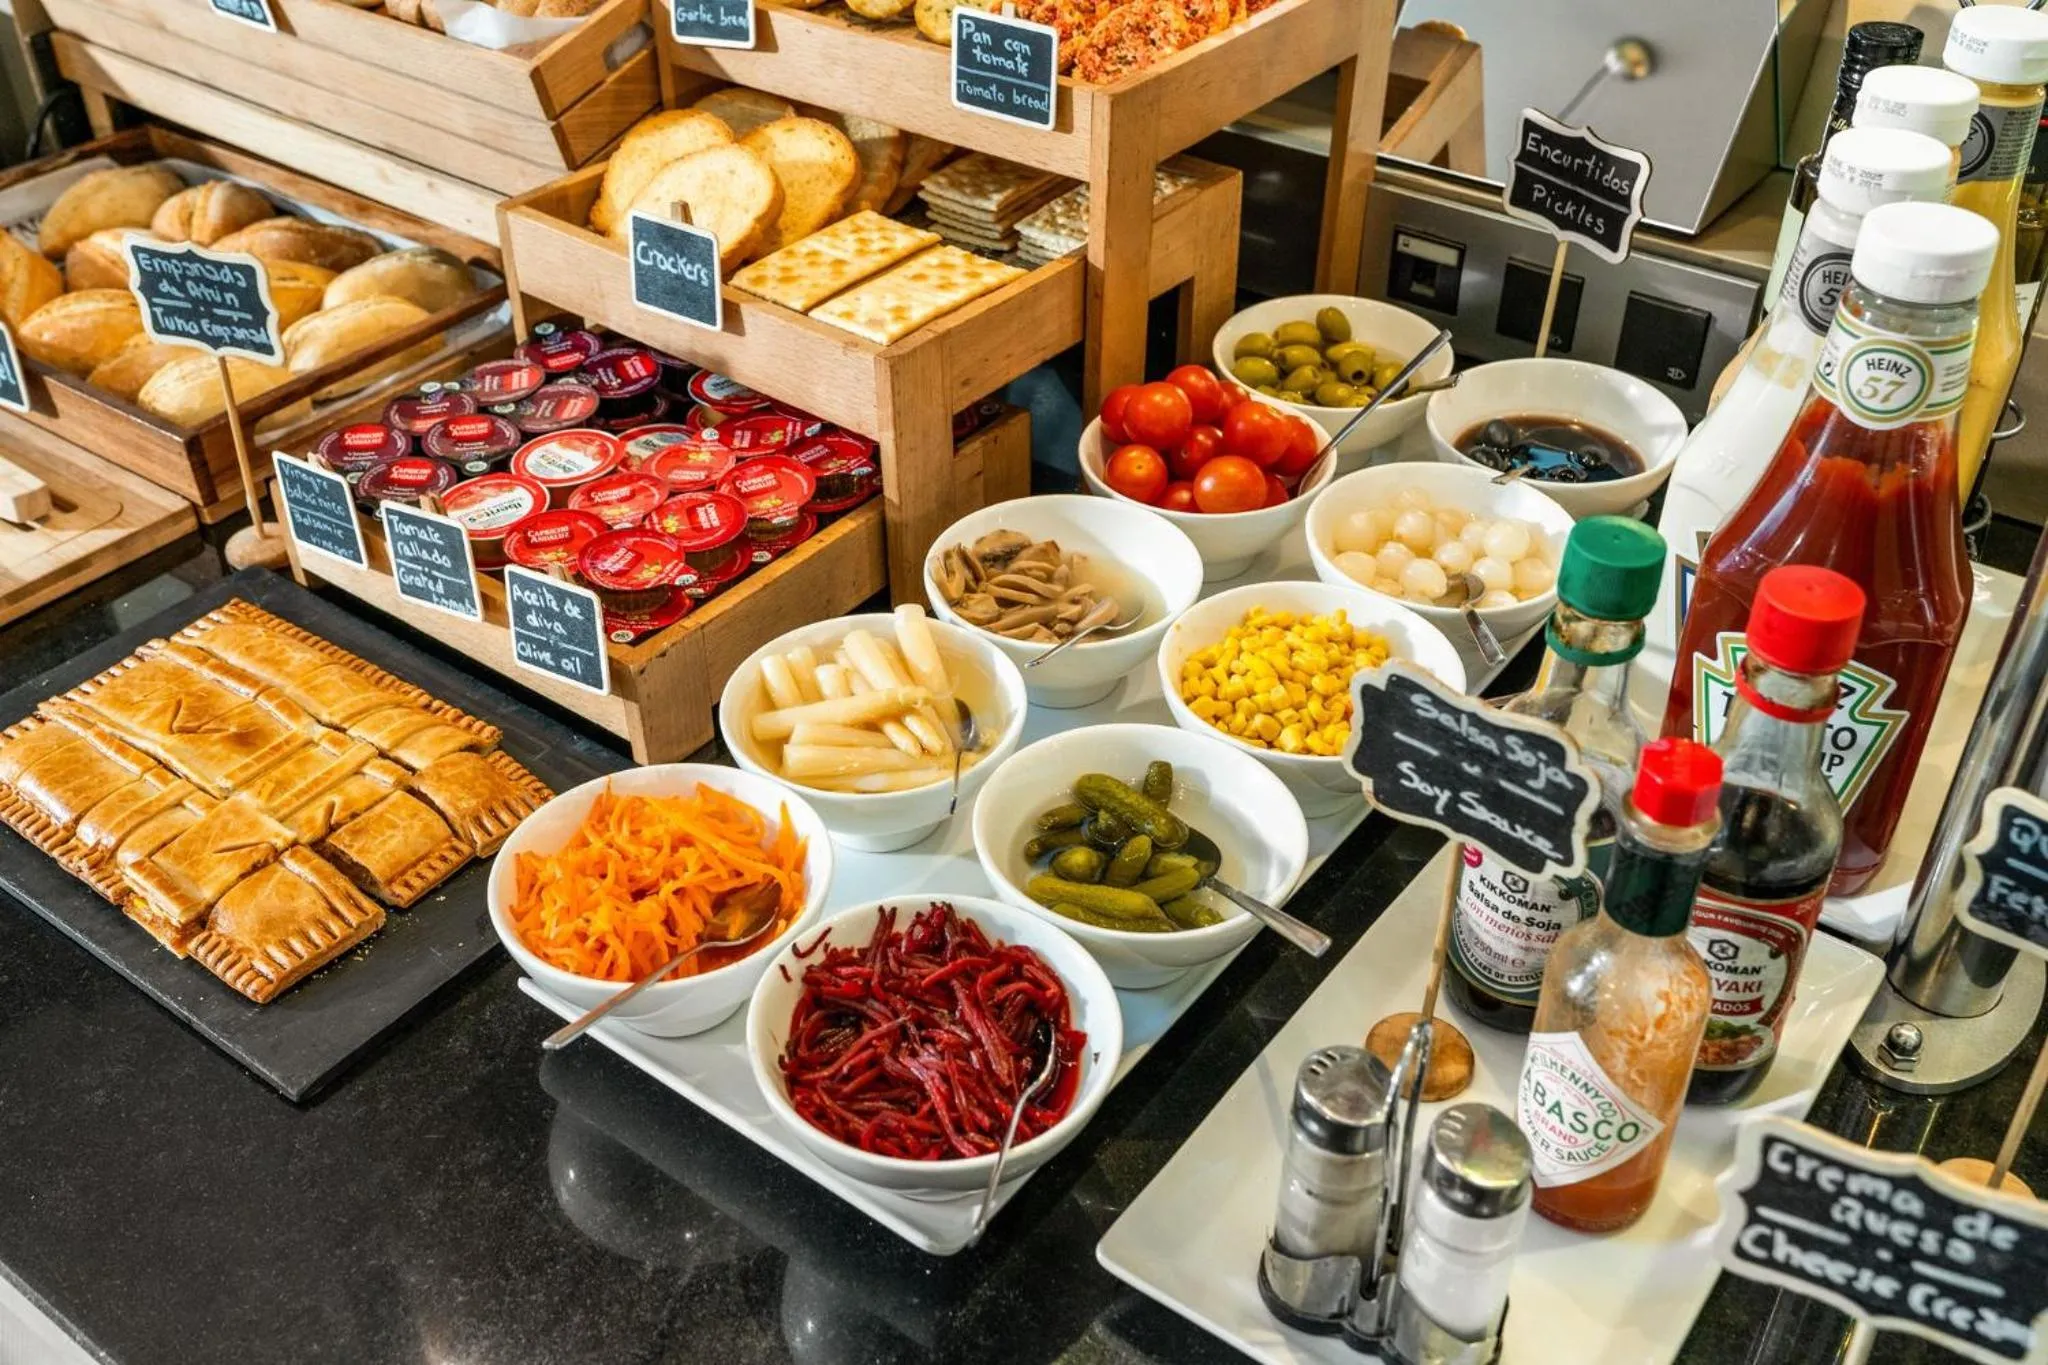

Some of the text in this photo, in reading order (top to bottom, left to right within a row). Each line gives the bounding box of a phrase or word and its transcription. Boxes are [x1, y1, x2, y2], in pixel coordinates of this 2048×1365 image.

[961, 19, 1031, 56] Pan con
[972, 46, 1029, 77] tomate
[958, 80, 1050, 112] Tomato bread
[1526, 132, 1630, 195] Encurtidos
[1532, 184, 1605, 234] Pickles
[137, 252, 247, 288] Empanada
[636, 241, 709, 287] Crackers
[1818, 288, 1842, 306] 5
[1866, 358, 1912, 379] HEINZ
[1856, 376, 1907, 404] 57
[388, 514, 445, 545] Tomate
[397, 541, 452, 568] rallado
[512, 583, 560, 612] Aceite
[517, 641, 581, 675] Olive oil
[1411, 693, 1574, 789] Salsa Soja
[1398, 761, 1564, 860] Soy Sauce
[1467, 880, 1562, 932] Salsa de Soja
[1479, 874, 1552, 914] KIKKOMAN
[1484, 914, 1533, 942] menos
[1533, 1109, 1579, 1145] BRAND
[1554, 1142, 1611, 1163] SAUCE
[1766, 1142, 2020, 1251] Crema de
[1739, 1223, 1901, 1299] Cheese
